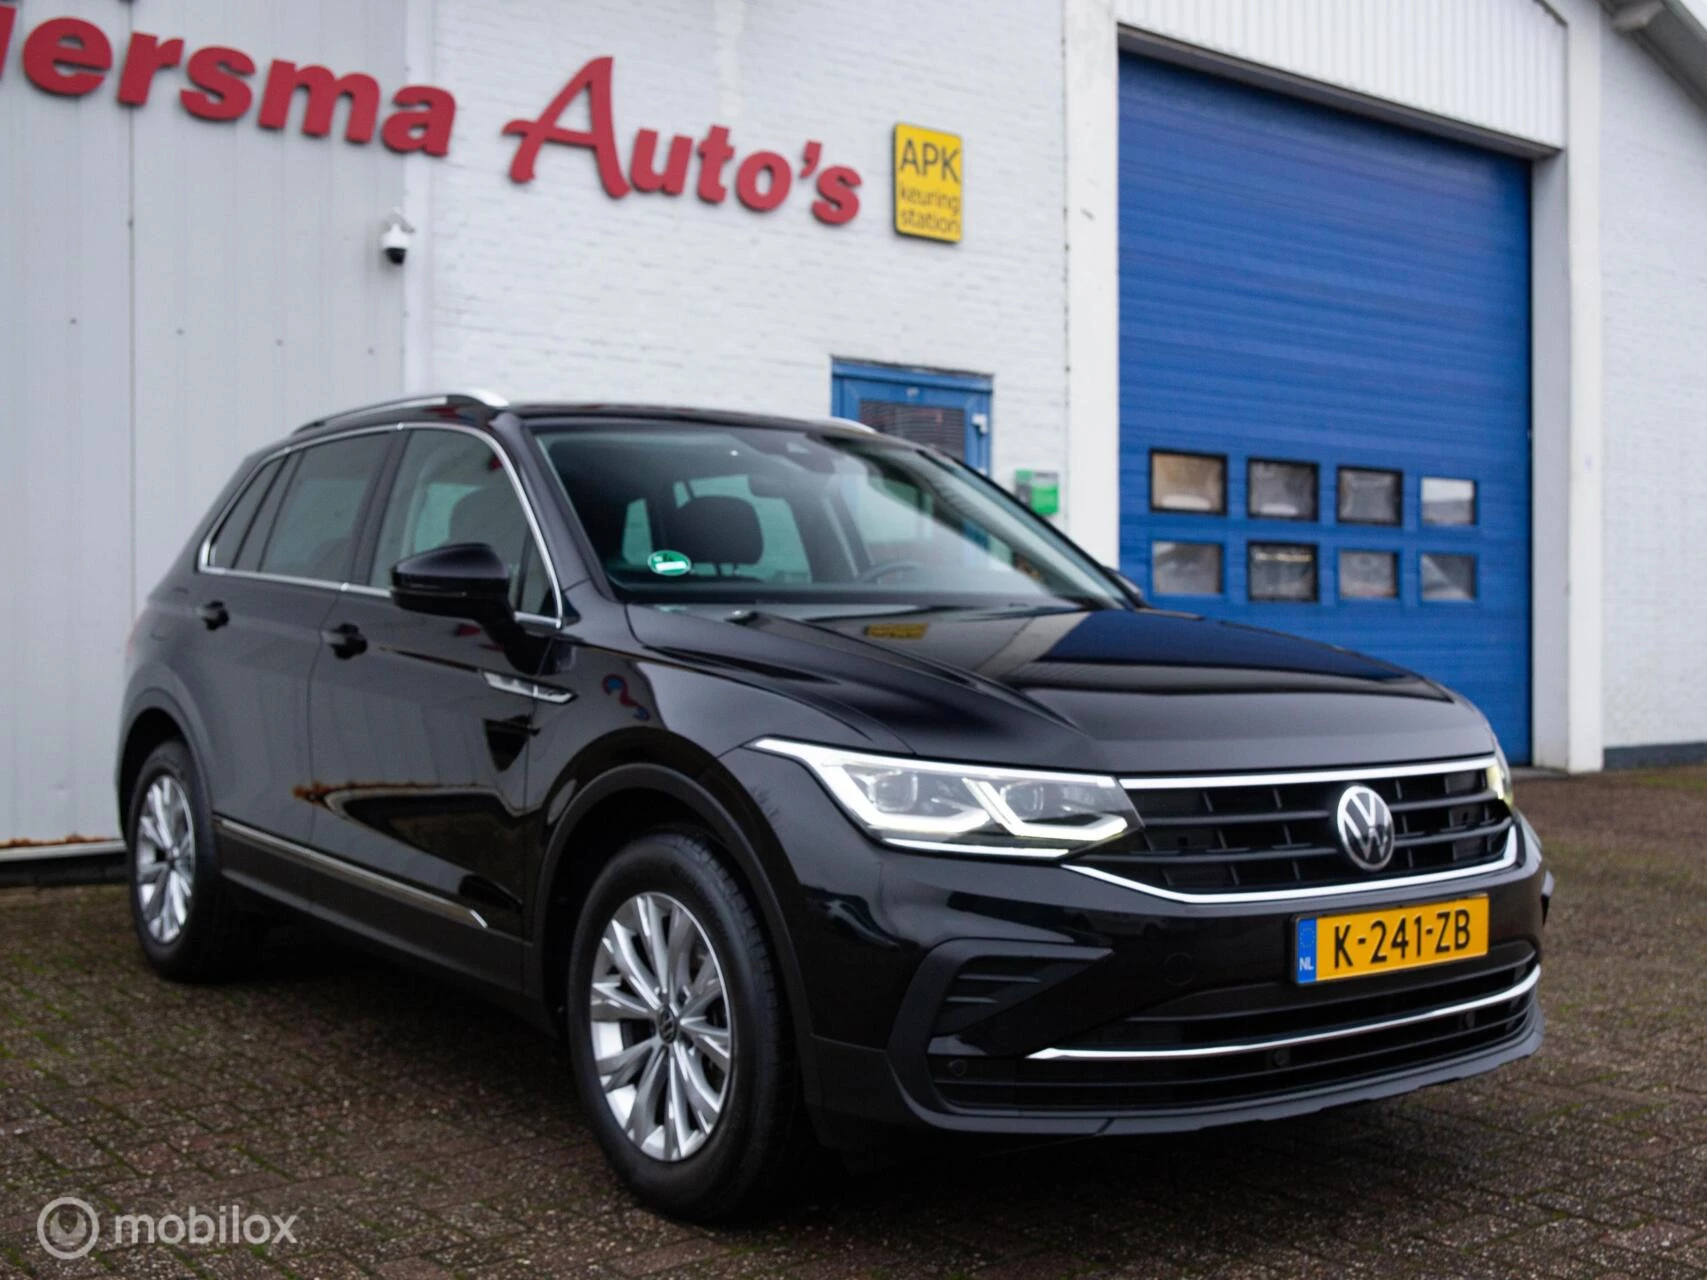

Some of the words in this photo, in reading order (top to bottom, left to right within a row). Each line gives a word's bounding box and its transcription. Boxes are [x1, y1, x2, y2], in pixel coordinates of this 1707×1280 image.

[0, 5, 456, 157] ersma
[501, 56, 863, 225] Auto's
[900, 138, 960, 184] APK
[901, 186, 960, 216] keuring
[901, 209, 960, 233] station
[1334, 909, 1471, 969] K-241-ZB
[1299, 957, 1314, 972] NL
